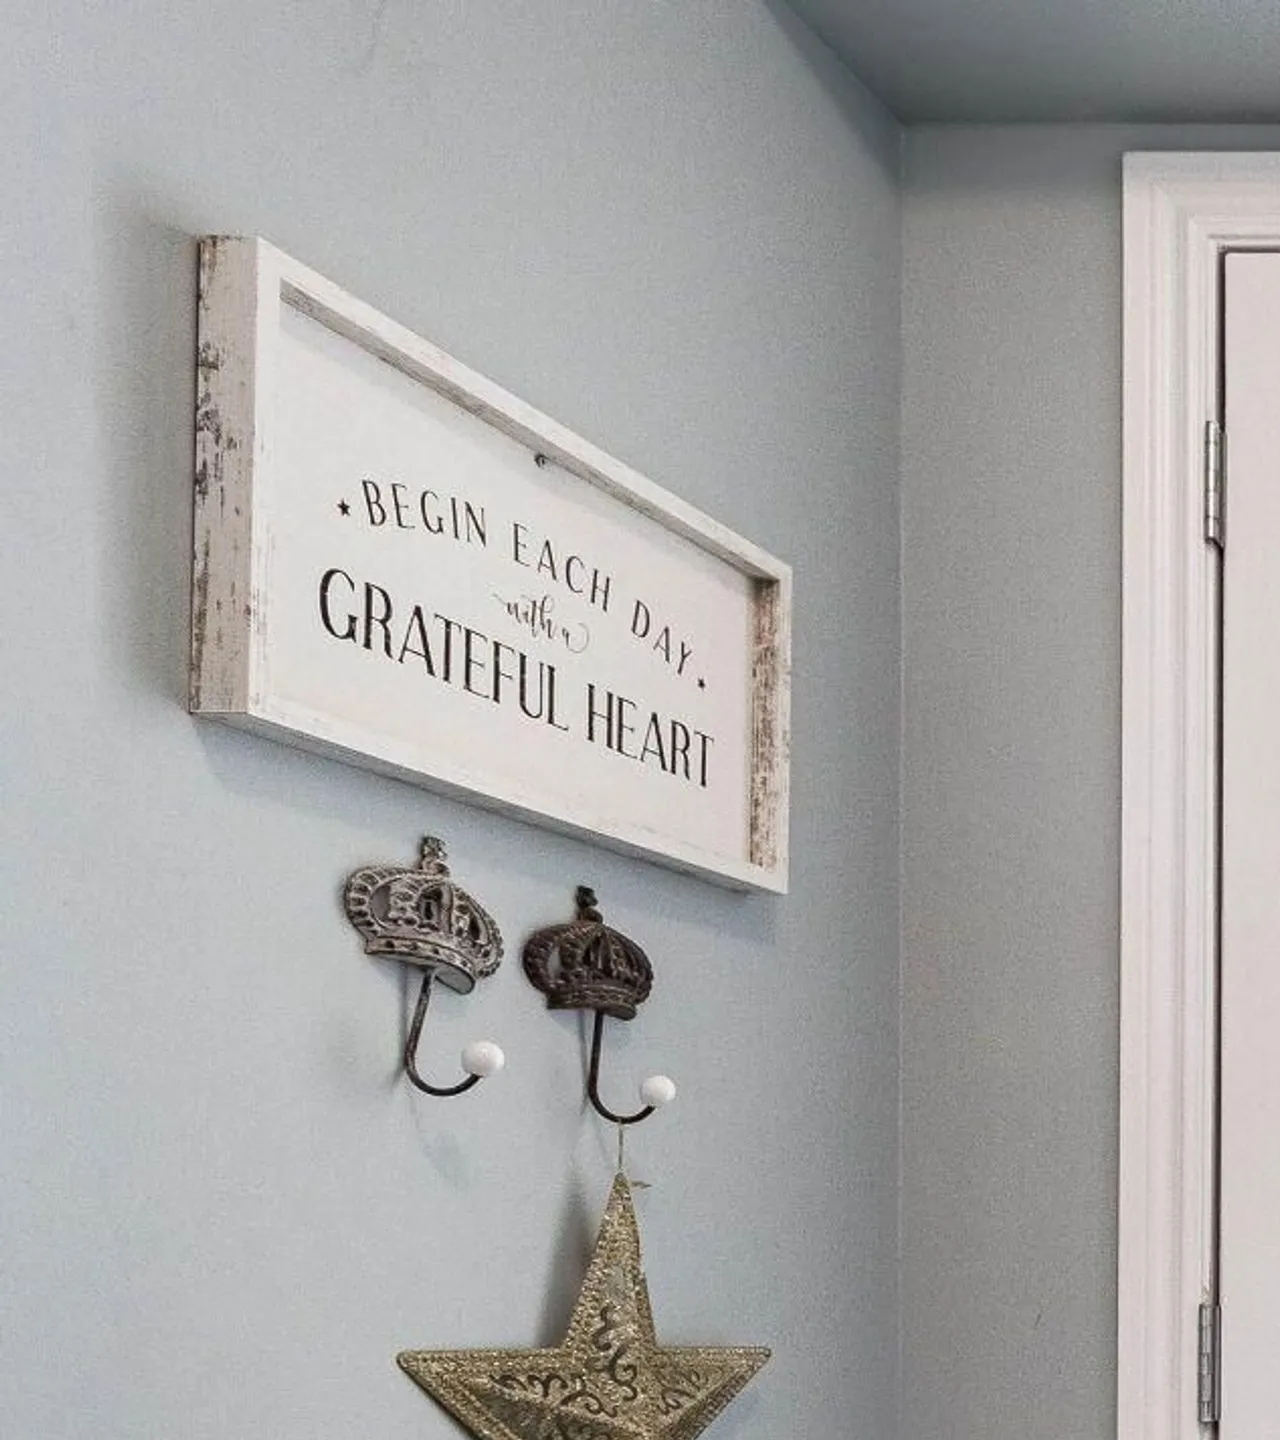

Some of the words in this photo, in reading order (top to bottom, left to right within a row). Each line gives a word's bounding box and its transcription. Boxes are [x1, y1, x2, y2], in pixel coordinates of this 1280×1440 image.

[318, 567, 570, 733] GRATEFUL
[585, 683, 716, 788] HEART
[362, 479, 488, 547] BEGIN
[513, 522, 612, 613] EACH
[630, 599, 695, 678] DAY
[493, 593, 556, 640] with
